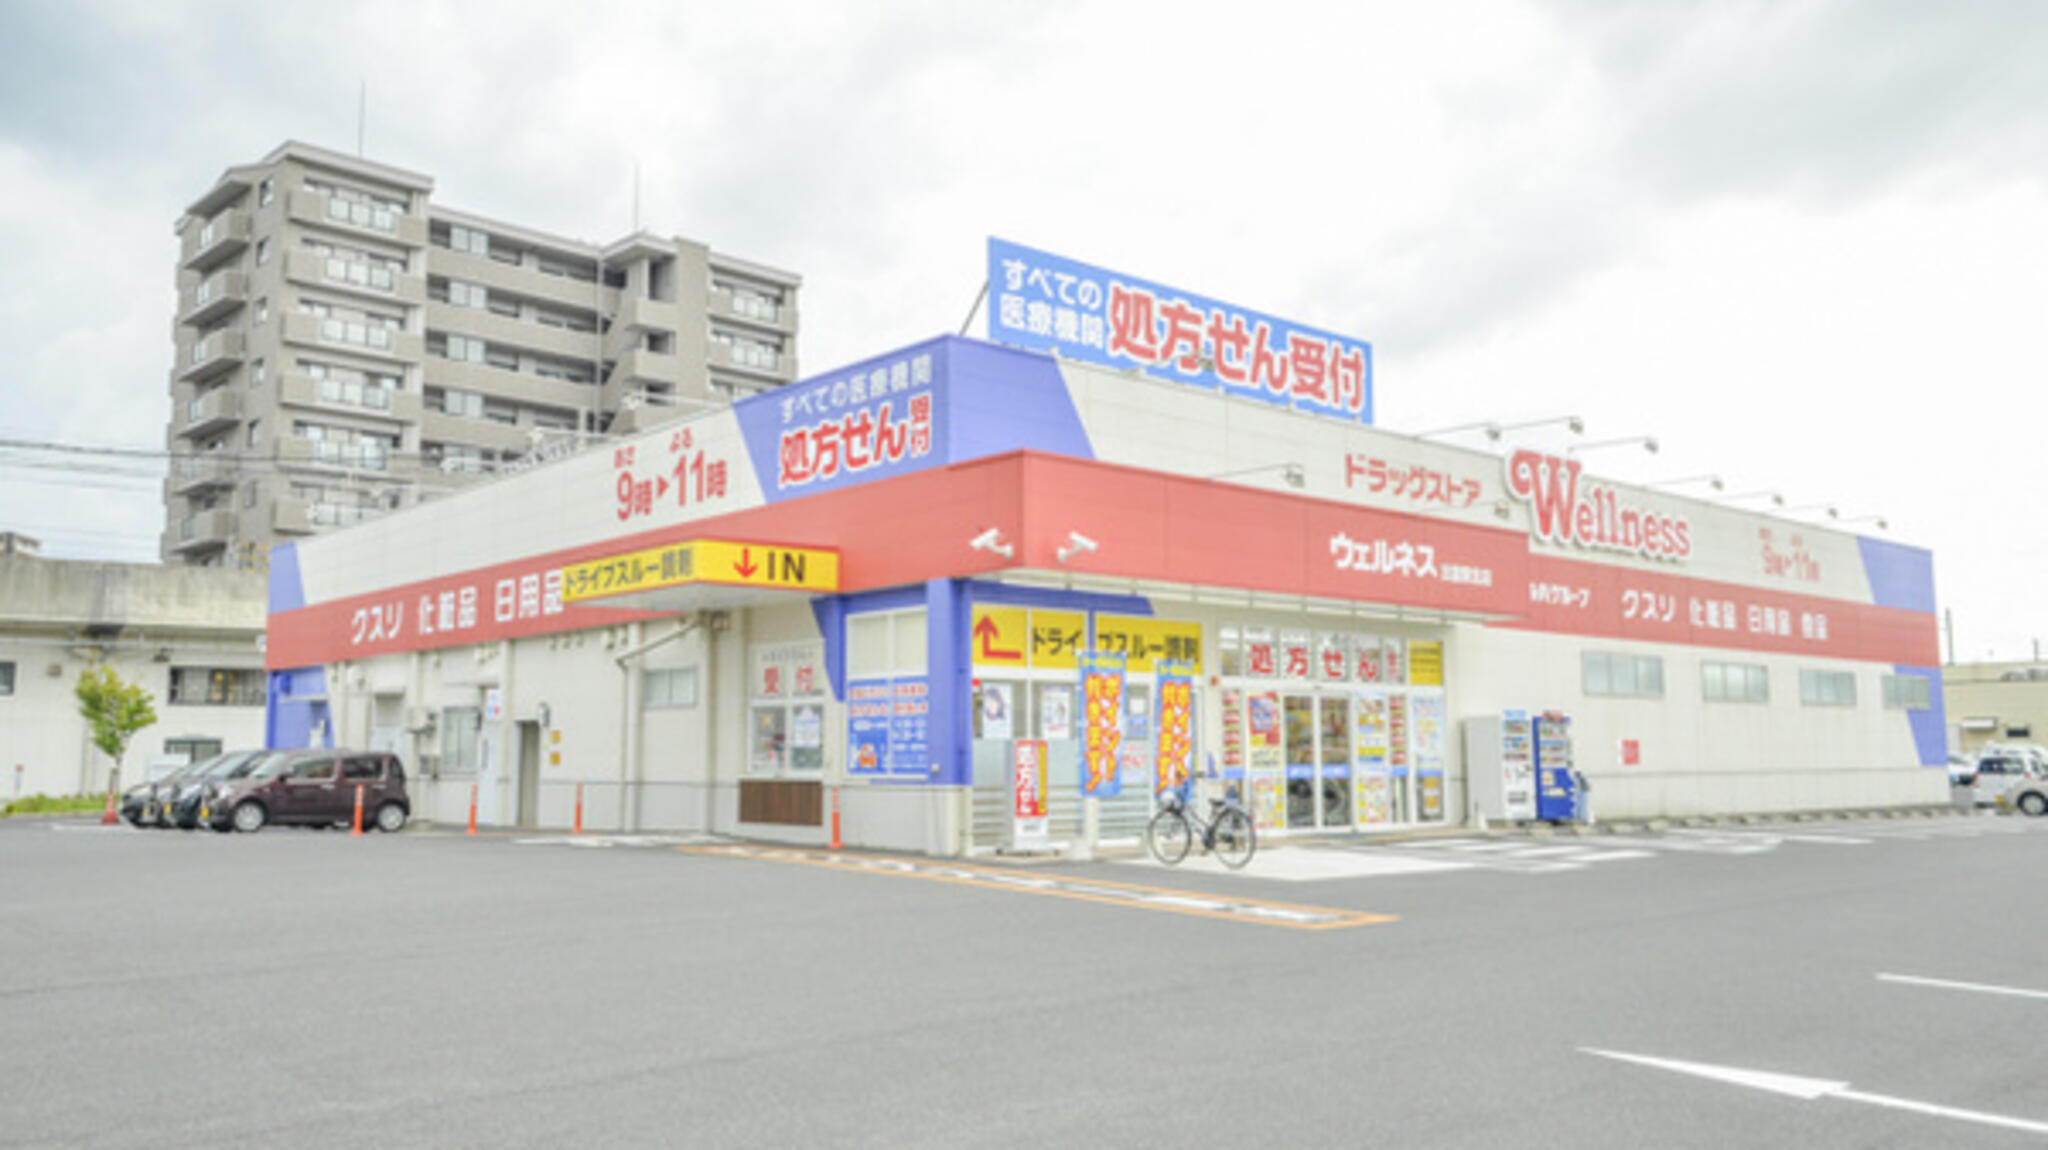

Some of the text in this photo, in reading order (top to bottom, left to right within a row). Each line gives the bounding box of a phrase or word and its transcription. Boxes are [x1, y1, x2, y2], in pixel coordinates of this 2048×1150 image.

[1002, 259, 1102, 310] すべての
[1000, 295, 1104, 350] 医療機関
[1108, 284, 1365, 410] 処方せん受付
[781, 354, 932, 425] すべての医療機関
[779, 402, 907, 486] 処方せん
[1344, 453, 1482, 507] ドラッグストア
[1509, 449, 1691, 558] Wellness
[767, 551, 806, 584] IN
[1328, 531, 1438, 578] ウェルネス
[351, 599, 405, 645] クスリ
[417, 585, 478, 636] 化粧品
[1621, 587, 1677, 623] クスリ
